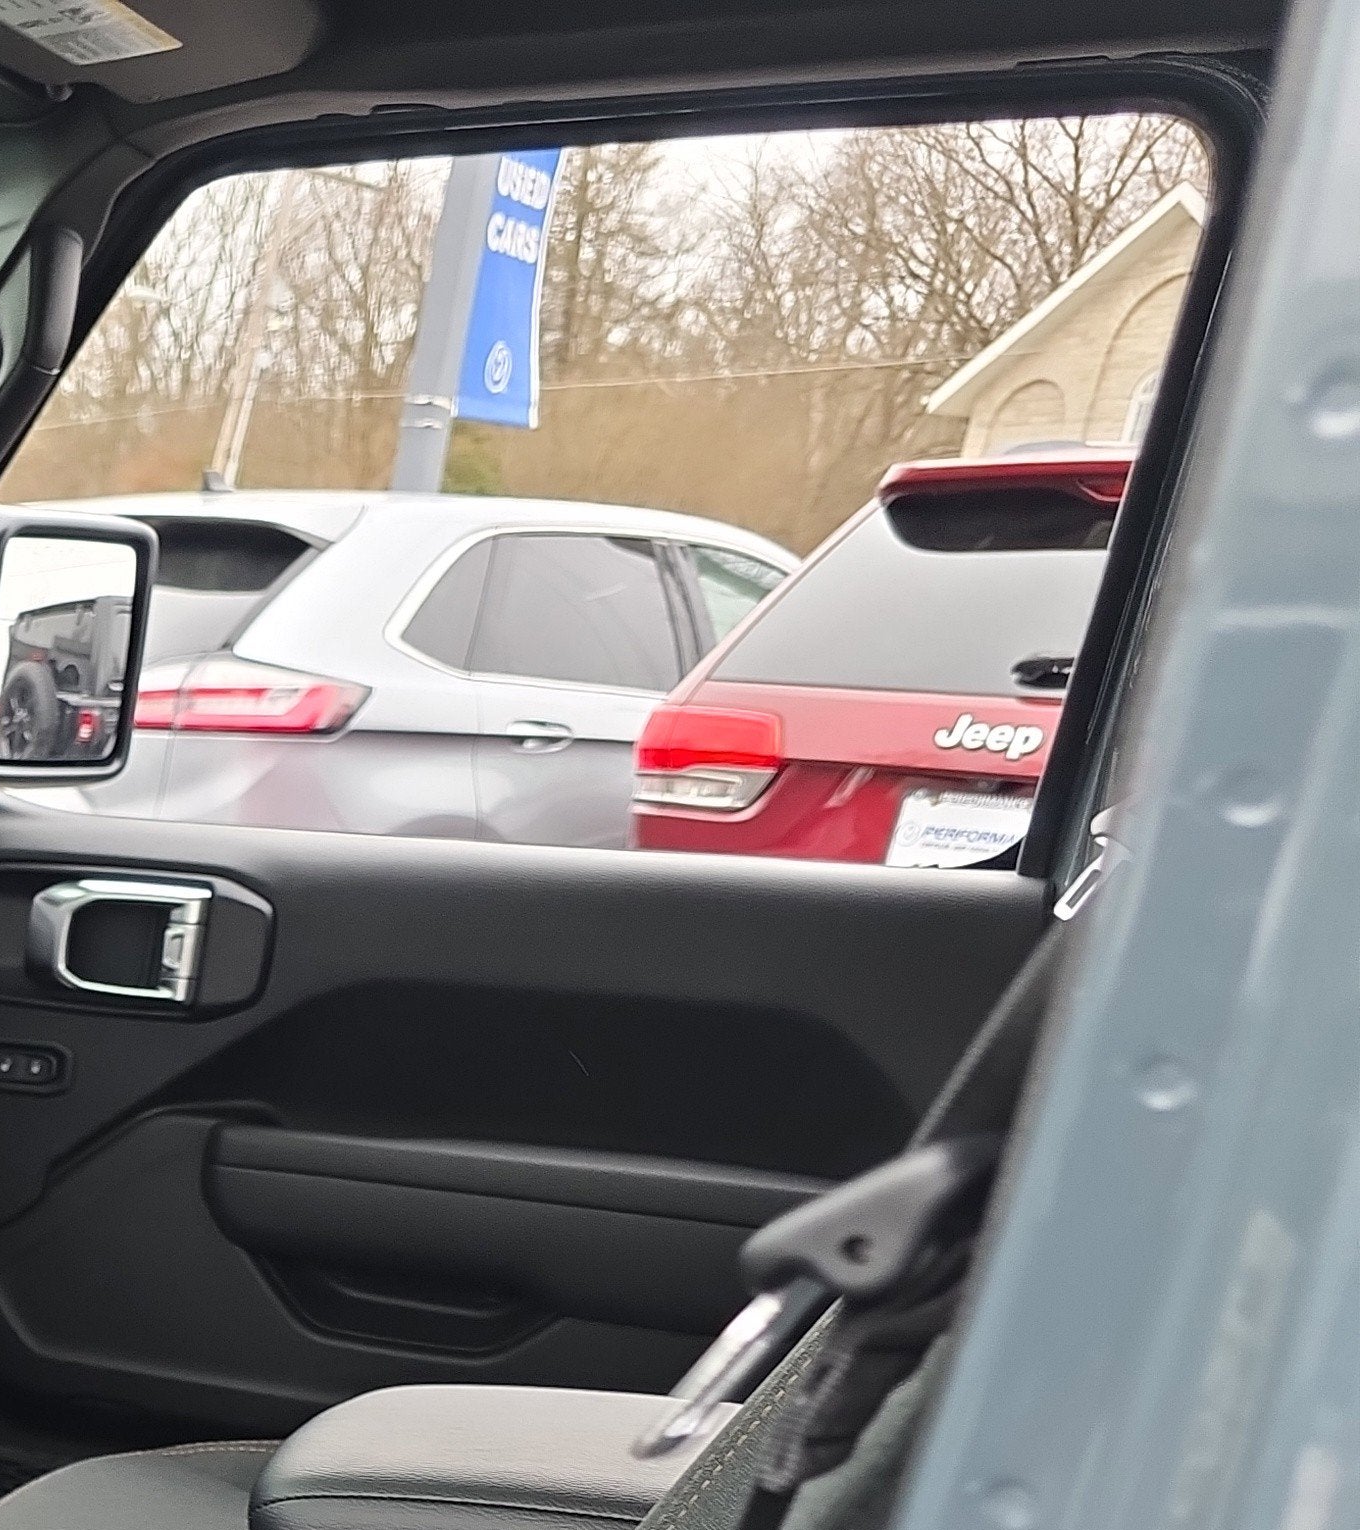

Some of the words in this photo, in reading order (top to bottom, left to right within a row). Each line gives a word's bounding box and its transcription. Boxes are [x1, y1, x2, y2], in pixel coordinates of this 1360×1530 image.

[497, 157, 551, 210] USED
[487, 212, 540, 264] CARS
[934, 714, 1044, 761] Jeep
